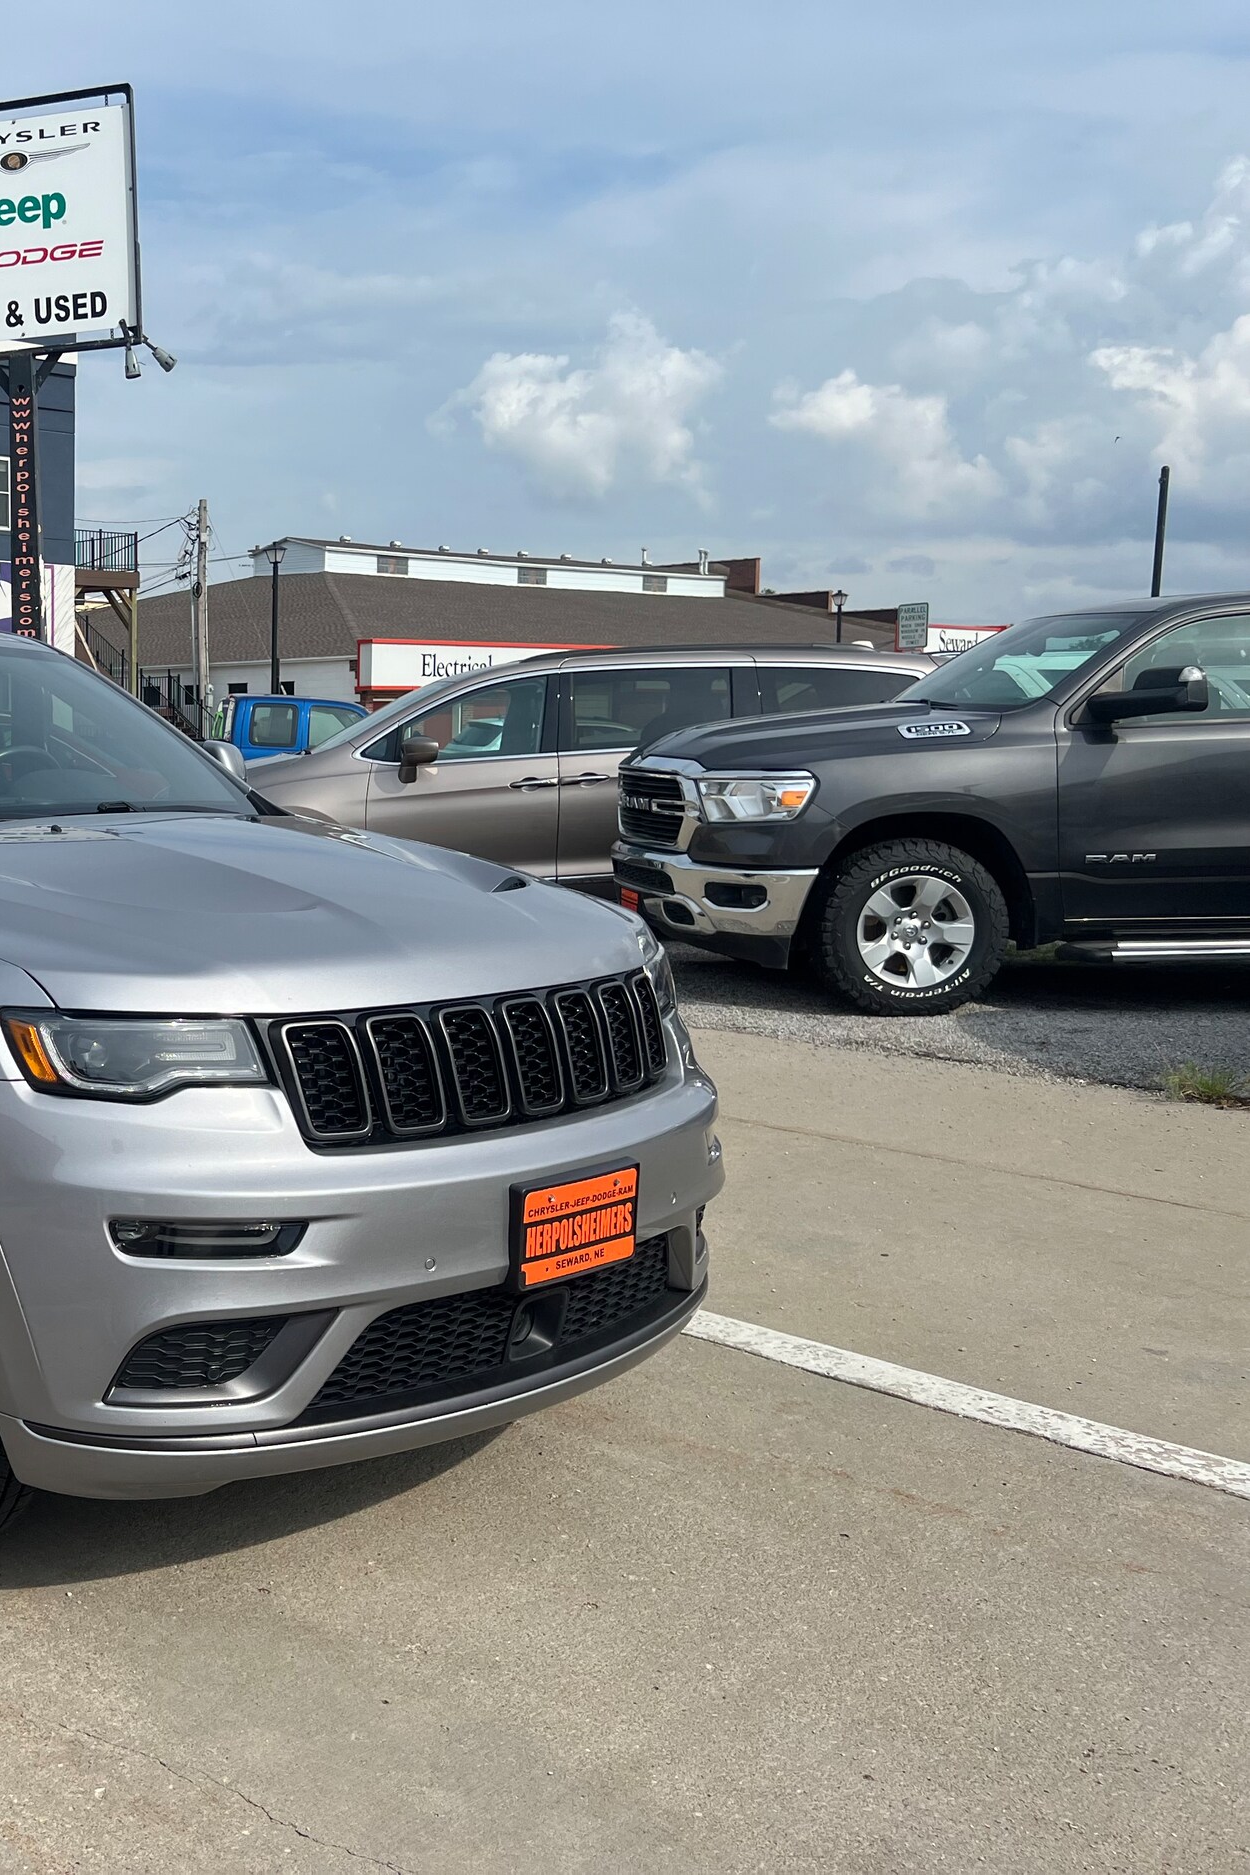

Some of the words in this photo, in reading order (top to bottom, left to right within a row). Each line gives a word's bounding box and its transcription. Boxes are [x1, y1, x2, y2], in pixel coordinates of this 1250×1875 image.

[5, 300, 24, 328] &
[34, 291, 108, 324] USED
[901, 614, 925, 622] PARKING
[939, 630, 978, 652] Seward
[910, 724, 958, 732] 1500
[621, 793, 649, 811] RAM
[1085, 853, 1157, 864] RAM
[870, 864, 963, 889] BFGoodrich
[863, 974, 885, 992] T/A
[890, 968, 971, 998] All-Terrain
[528, 1185, 634, 1218] CHRYSLER-JEEP-DODGE-RAM
[526, 1202, 632, 1258] HERPOLSHEIMERS
[555, 1253, 592, 1270] SEWARD,
[594, 1248, 605, 1259] NE
